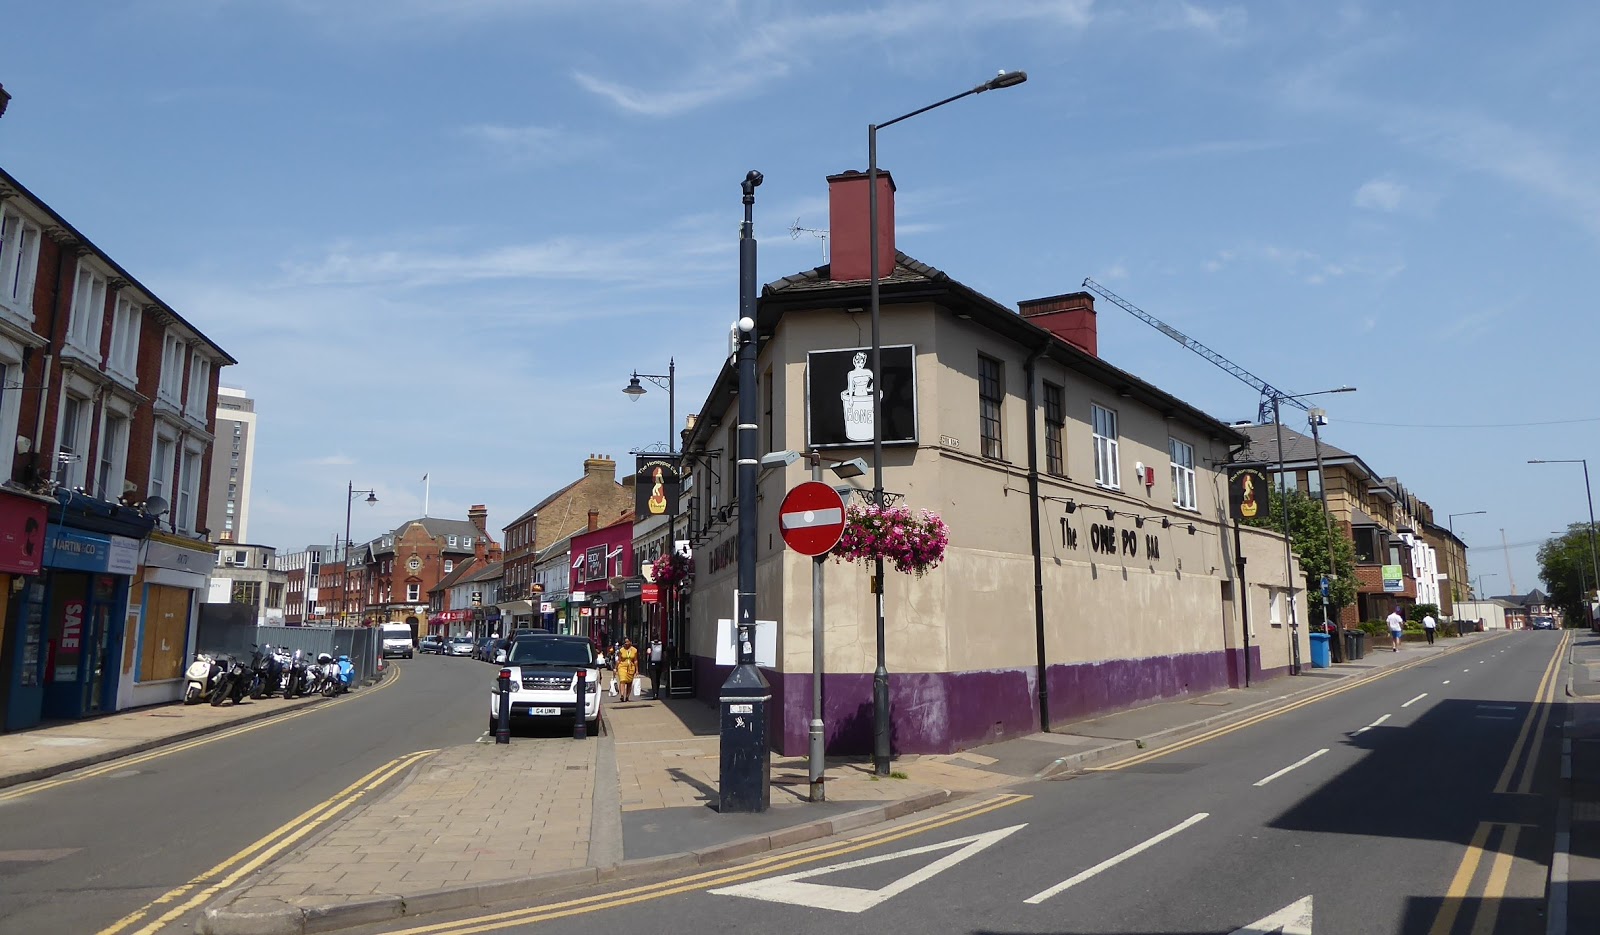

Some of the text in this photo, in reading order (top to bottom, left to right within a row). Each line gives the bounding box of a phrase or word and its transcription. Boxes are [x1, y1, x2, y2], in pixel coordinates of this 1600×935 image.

[847, 407, 874, 424] HONE
[1060, 517, 1077, 551] The
[1091, 523, 1116, 555] ONE
[1121, 528, 1137, 558] PO
[61, 604, 82, 648] SALE
